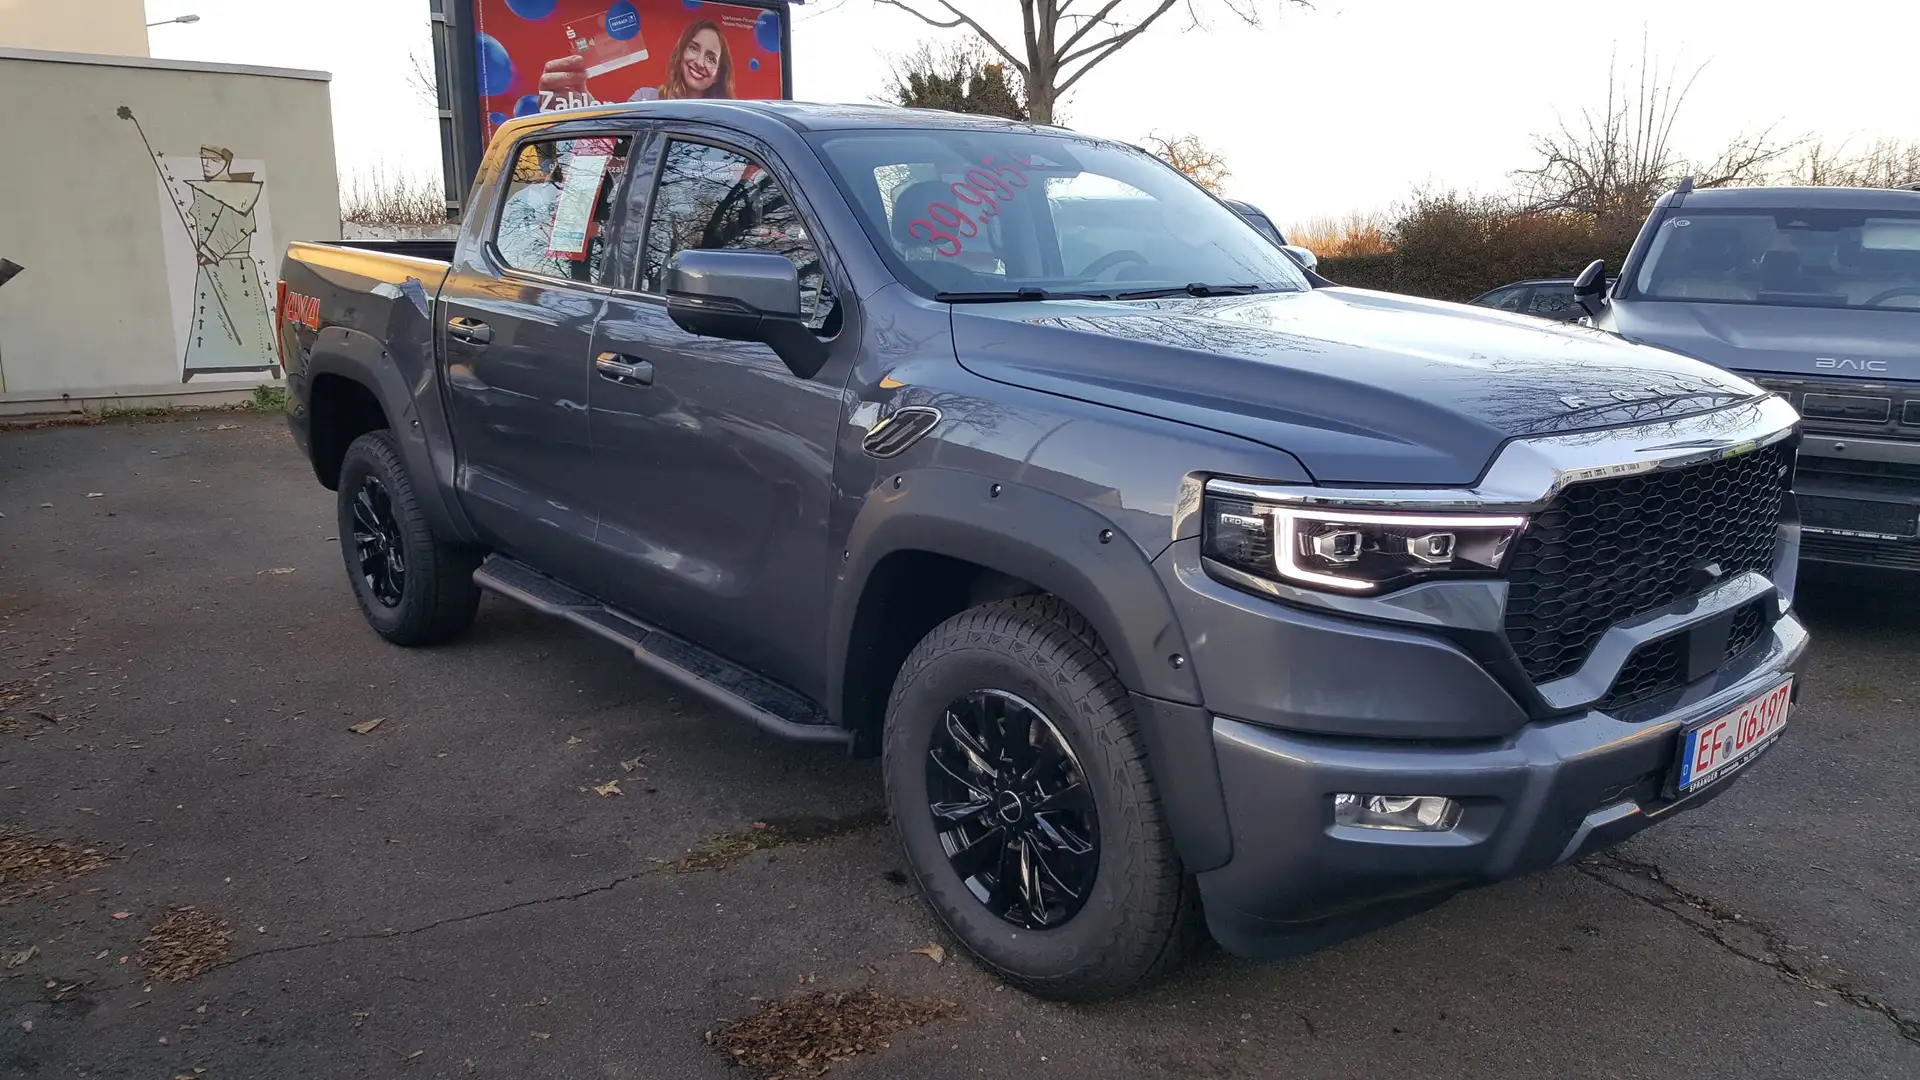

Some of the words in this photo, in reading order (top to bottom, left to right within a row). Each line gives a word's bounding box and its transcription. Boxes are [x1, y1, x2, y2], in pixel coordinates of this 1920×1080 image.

[1815, 357, 1888, 372] BAIC
[1696, 722, 1726, 773] EF
[1736, 685, 1788, 750] 06197
[1689, 771, 1718, 792] SPRANGER
